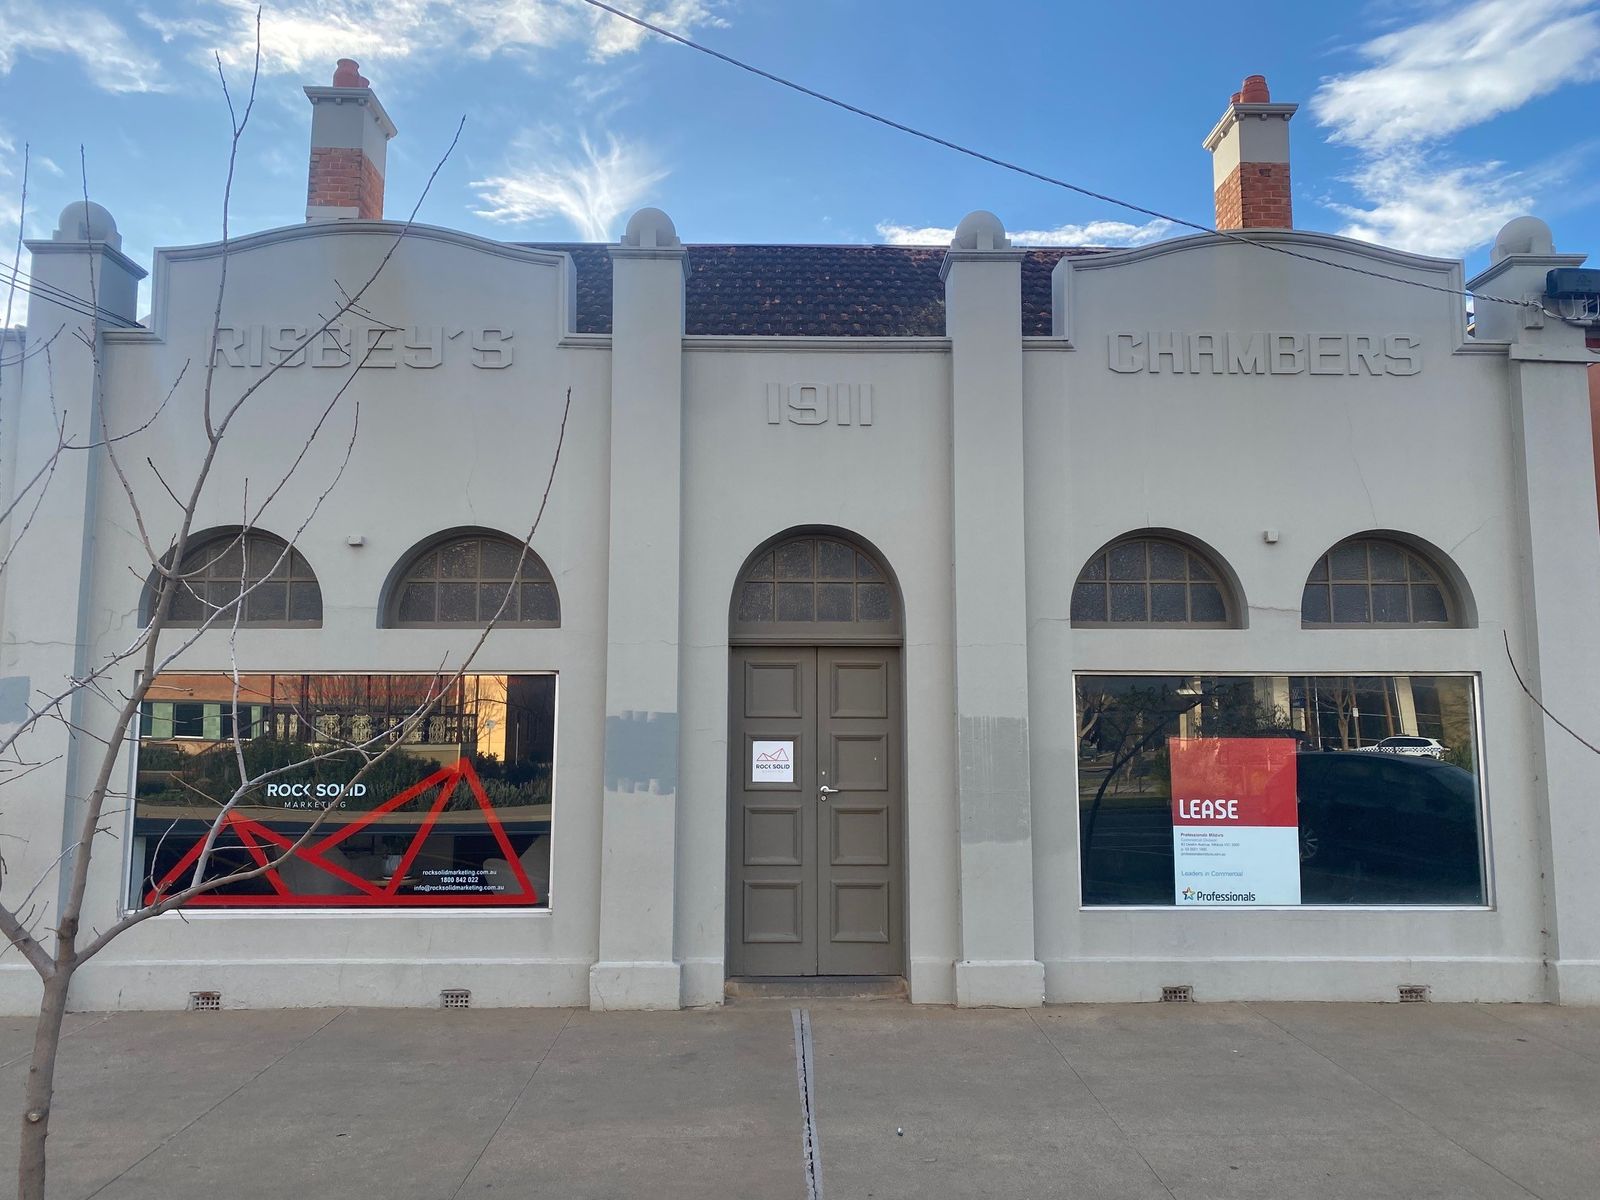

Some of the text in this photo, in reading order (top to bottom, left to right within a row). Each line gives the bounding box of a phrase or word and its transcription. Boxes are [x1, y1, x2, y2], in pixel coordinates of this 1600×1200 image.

[204, 325, 513, 369] RISBEY'S
[1107, 330, 1421, 376] CHAMBERS
[766, 382, 872, 426] 1911
[267, 783, 311, 797] ROCK
[1179, 799, 1239, 819] LEASE
[413, 884, 505, 892] info@rocksolidmarketing.com.au
[1196, 891, 1256, 902] Professionals
